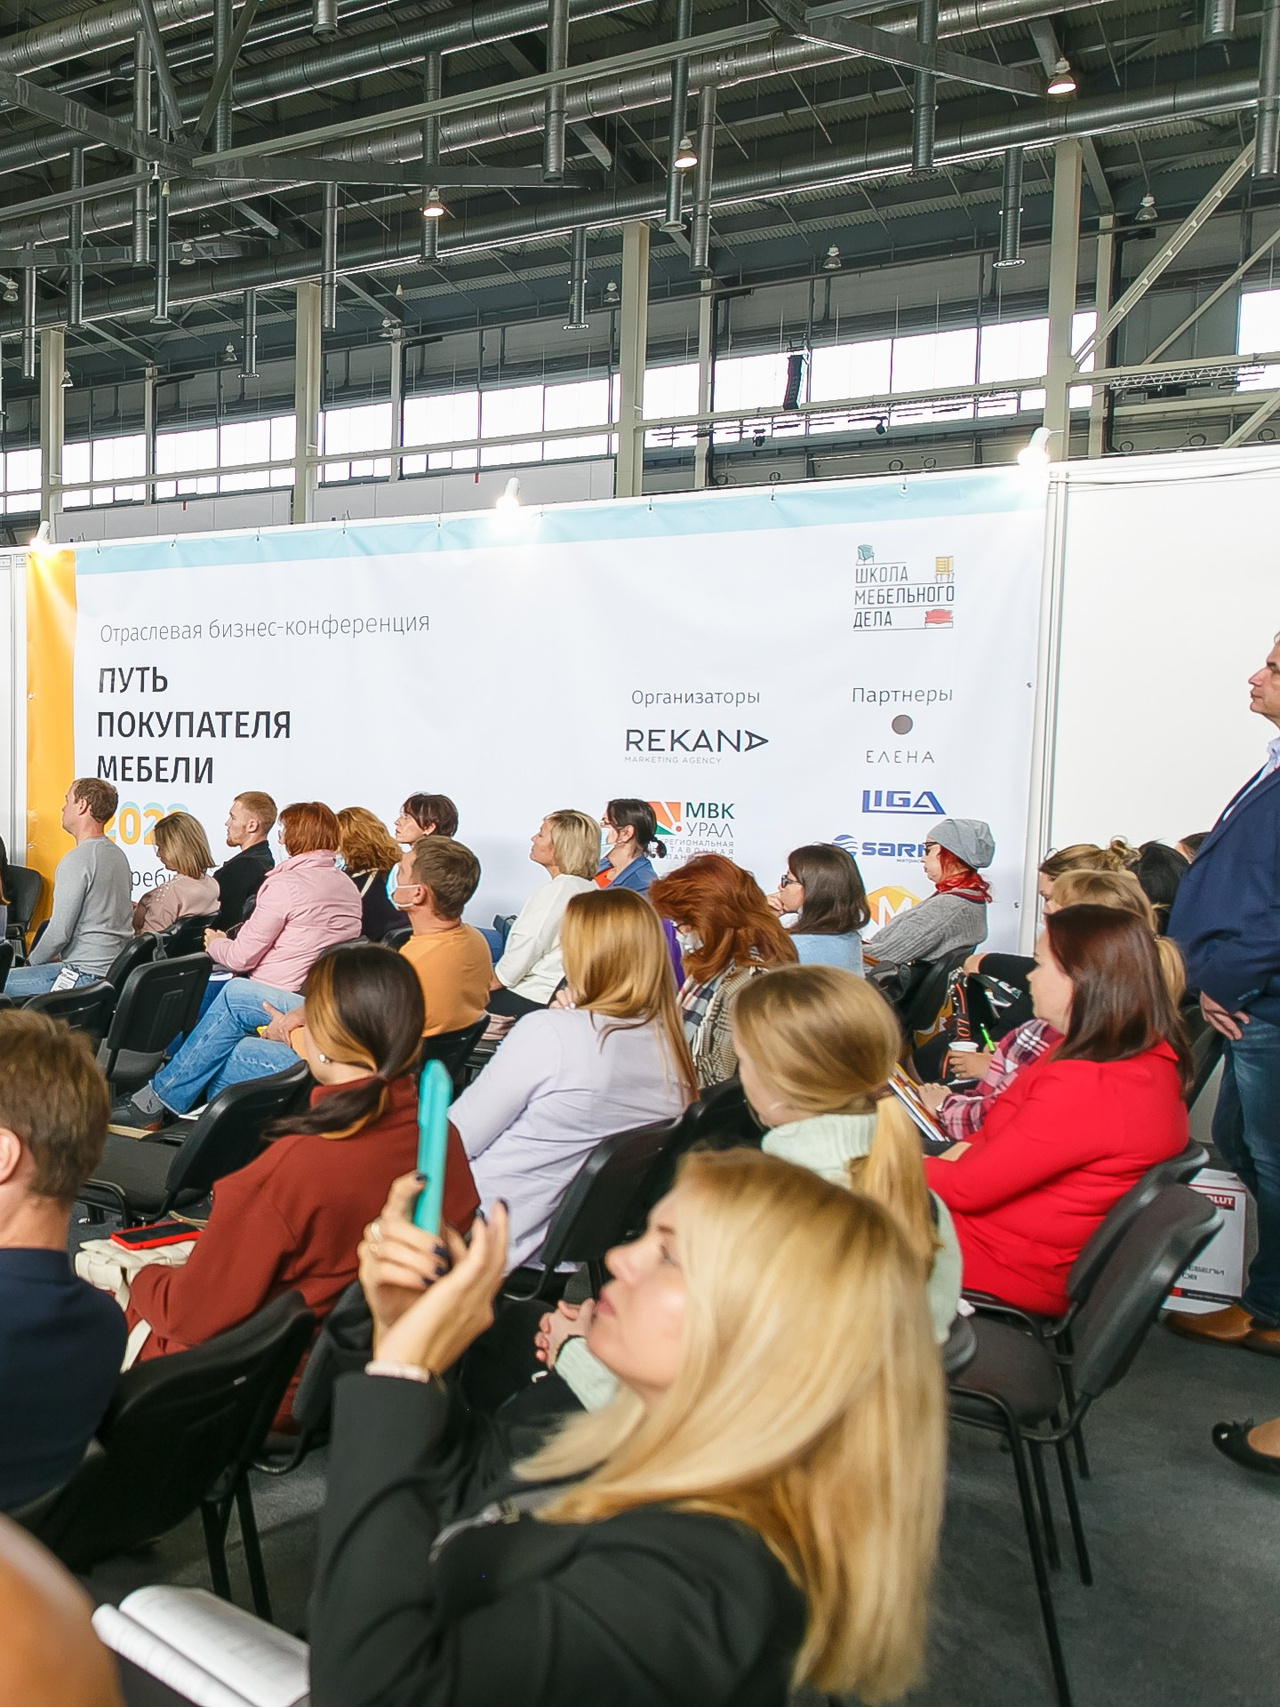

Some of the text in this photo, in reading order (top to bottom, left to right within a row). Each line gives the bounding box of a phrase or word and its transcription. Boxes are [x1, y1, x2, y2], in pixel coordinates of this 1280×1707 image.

[855, 566, 909, 584] ШКОЛА
[854, 585, 955, 606] МЕБЕЛЬНОГО
[853, 610, 893, 629] ДЕЛА
[100, 614, 430, 646] Отраслевая бизнес-конференция
[98, 666, 169, 694] ПУТЬ
[631, 689, 760, 708] Организаторы
[852, 687, 953, 706] Партнеры
[97, 710, 291, 739] ПОКУПАТЕЛЯ
[624, 756, 679, 764] MARKETING
[866, 750, 935, 764] ЕЛЕНА
[97, 755, 214, 784] МЕБЕЛИ
[685, 802, 736, 819] МВК
[862, 790, 947, 815] LIGA
[686, 822, 734, 838] УРАЛ
[663, 839, 734, 848] РЕГИОНАЛЬНАЯ
